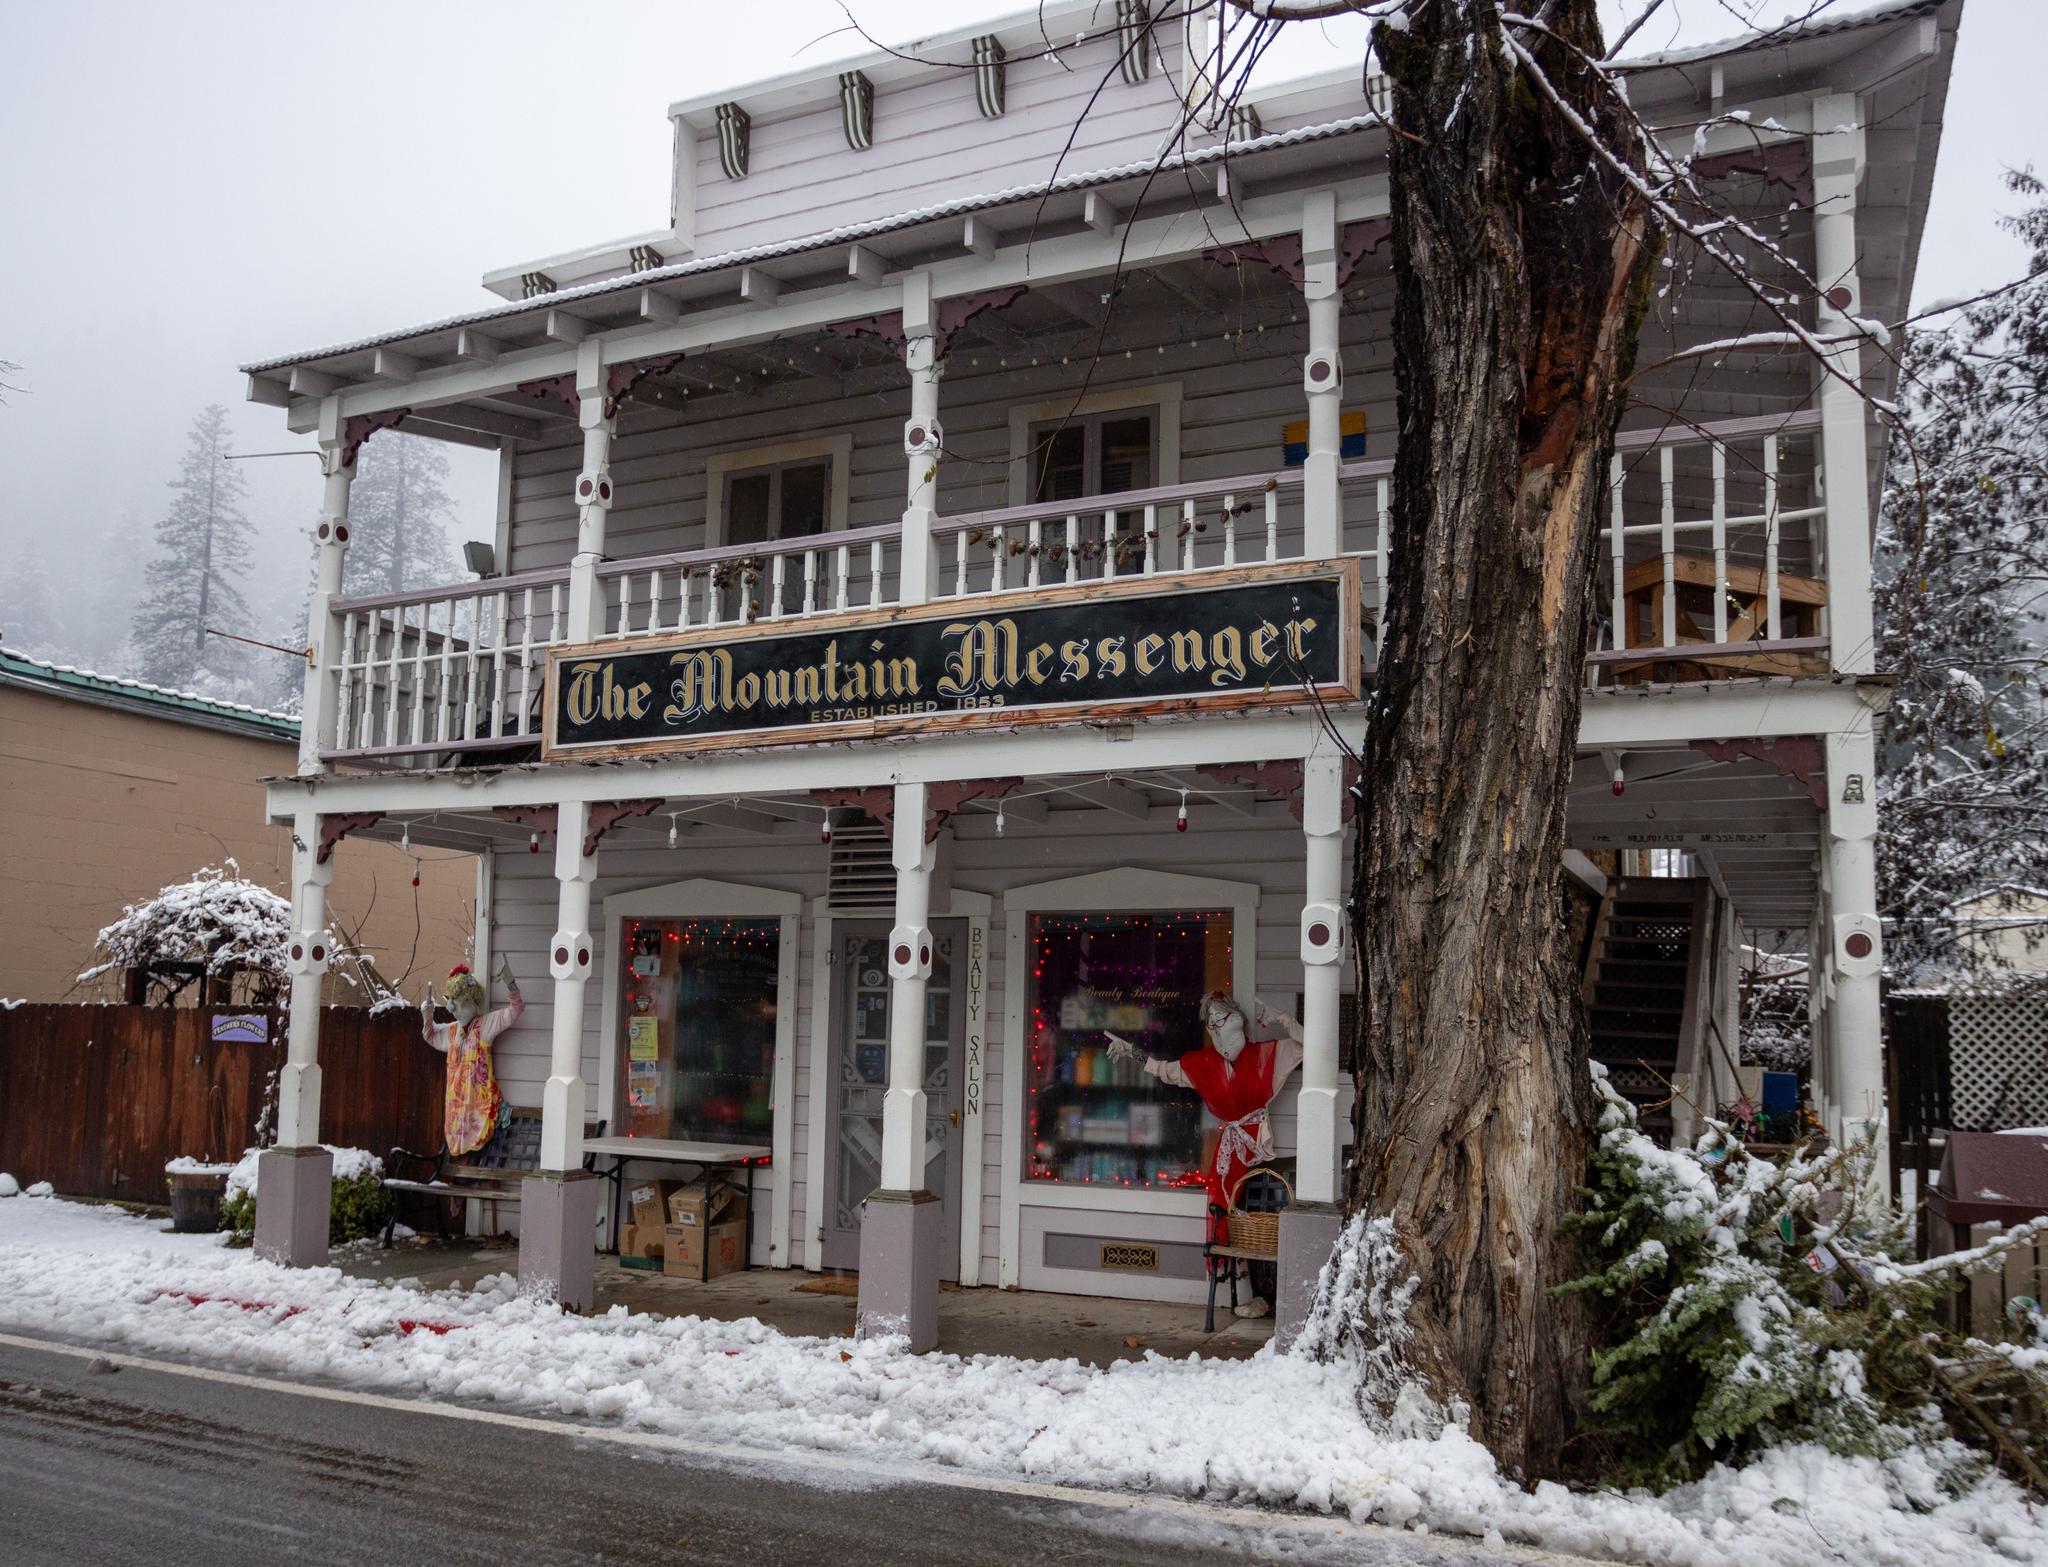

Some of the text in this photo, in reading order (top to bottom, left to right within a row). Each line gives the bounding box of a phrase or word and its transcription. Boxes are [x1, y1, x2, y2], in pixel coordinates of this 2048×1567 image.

[567, 617, 1319, 726] The Mountain Messenger
[811, 694, 1005, 722] ESTABLISHED 1853
[967, 927, 982, 1115] BEAUTY SALON
[1086, 985, 1180, 1003] Beauty Boutique
